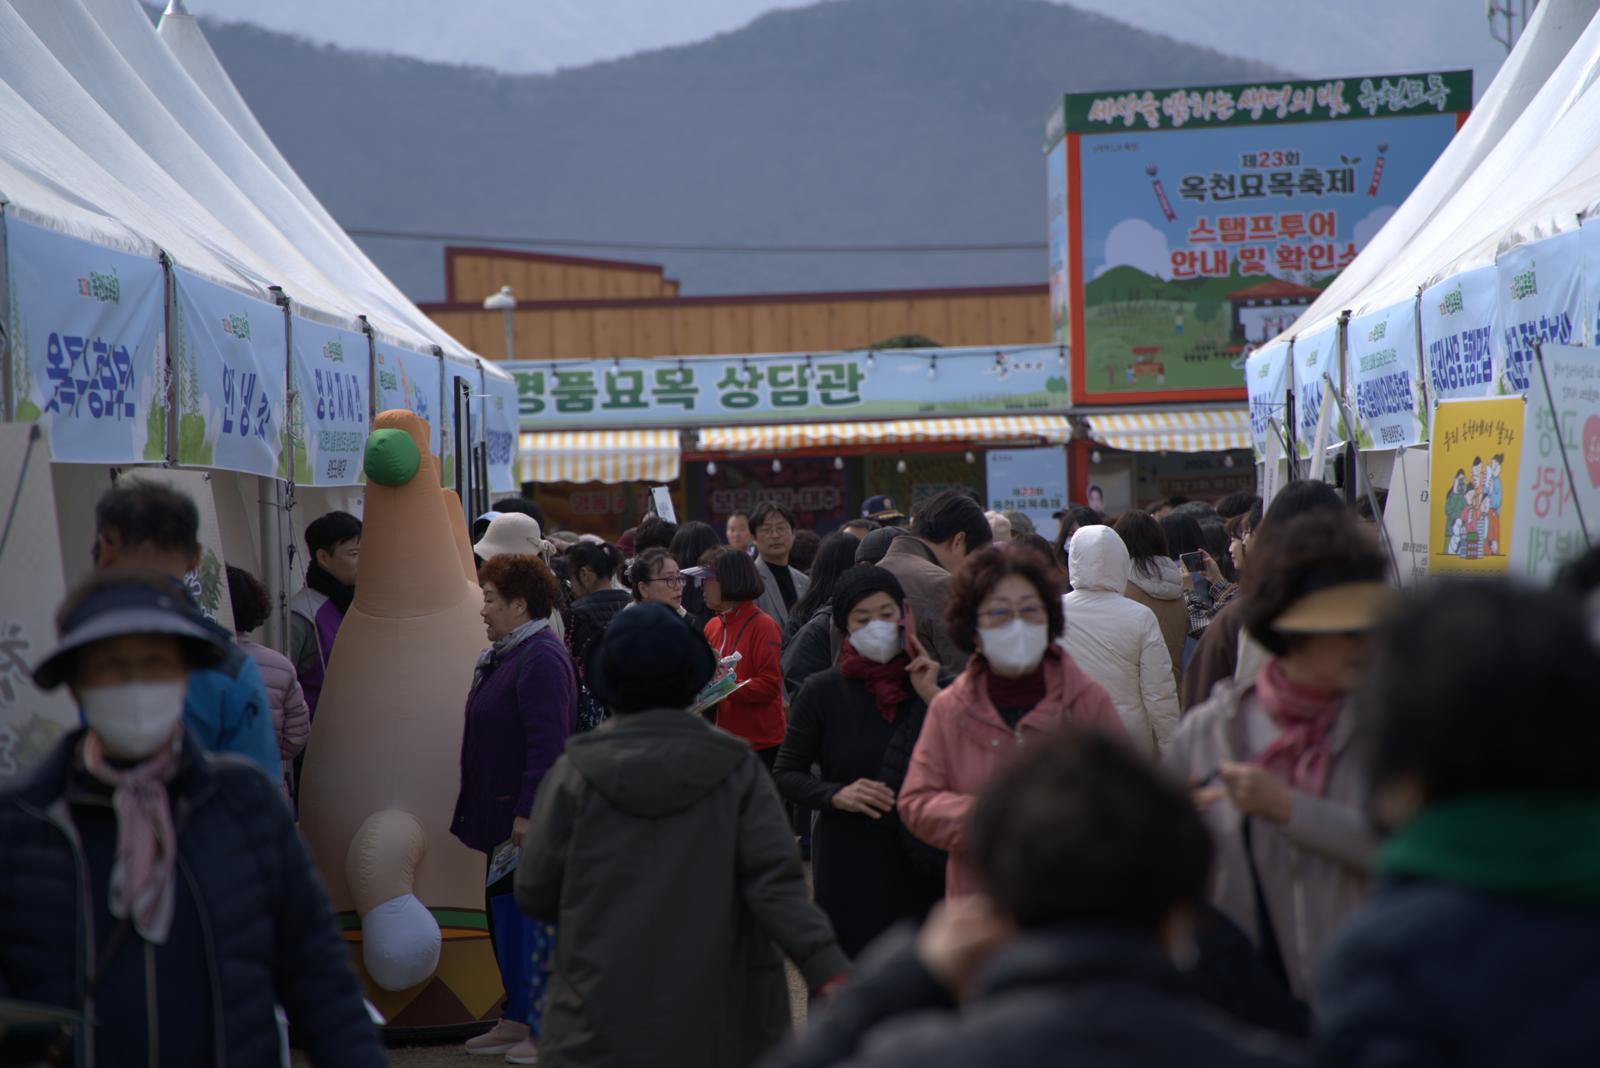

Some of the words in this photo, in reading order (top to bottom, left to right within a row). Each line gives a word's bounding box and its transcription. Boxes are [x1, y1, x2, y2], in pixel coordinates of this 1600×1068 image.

[1241, 151, 1301, 168] 제23회
[1179, 167, 1356, 202] 옥천묘목축제
[1188, 210, 1338, 244] 스탬프투어
[1169, 248, 1229, 277] 안내
[1237, 246, 1267, 274] 및
[516, 368, 700, 416] 명품묘목
[715, 361, 866, 410] 상담관
